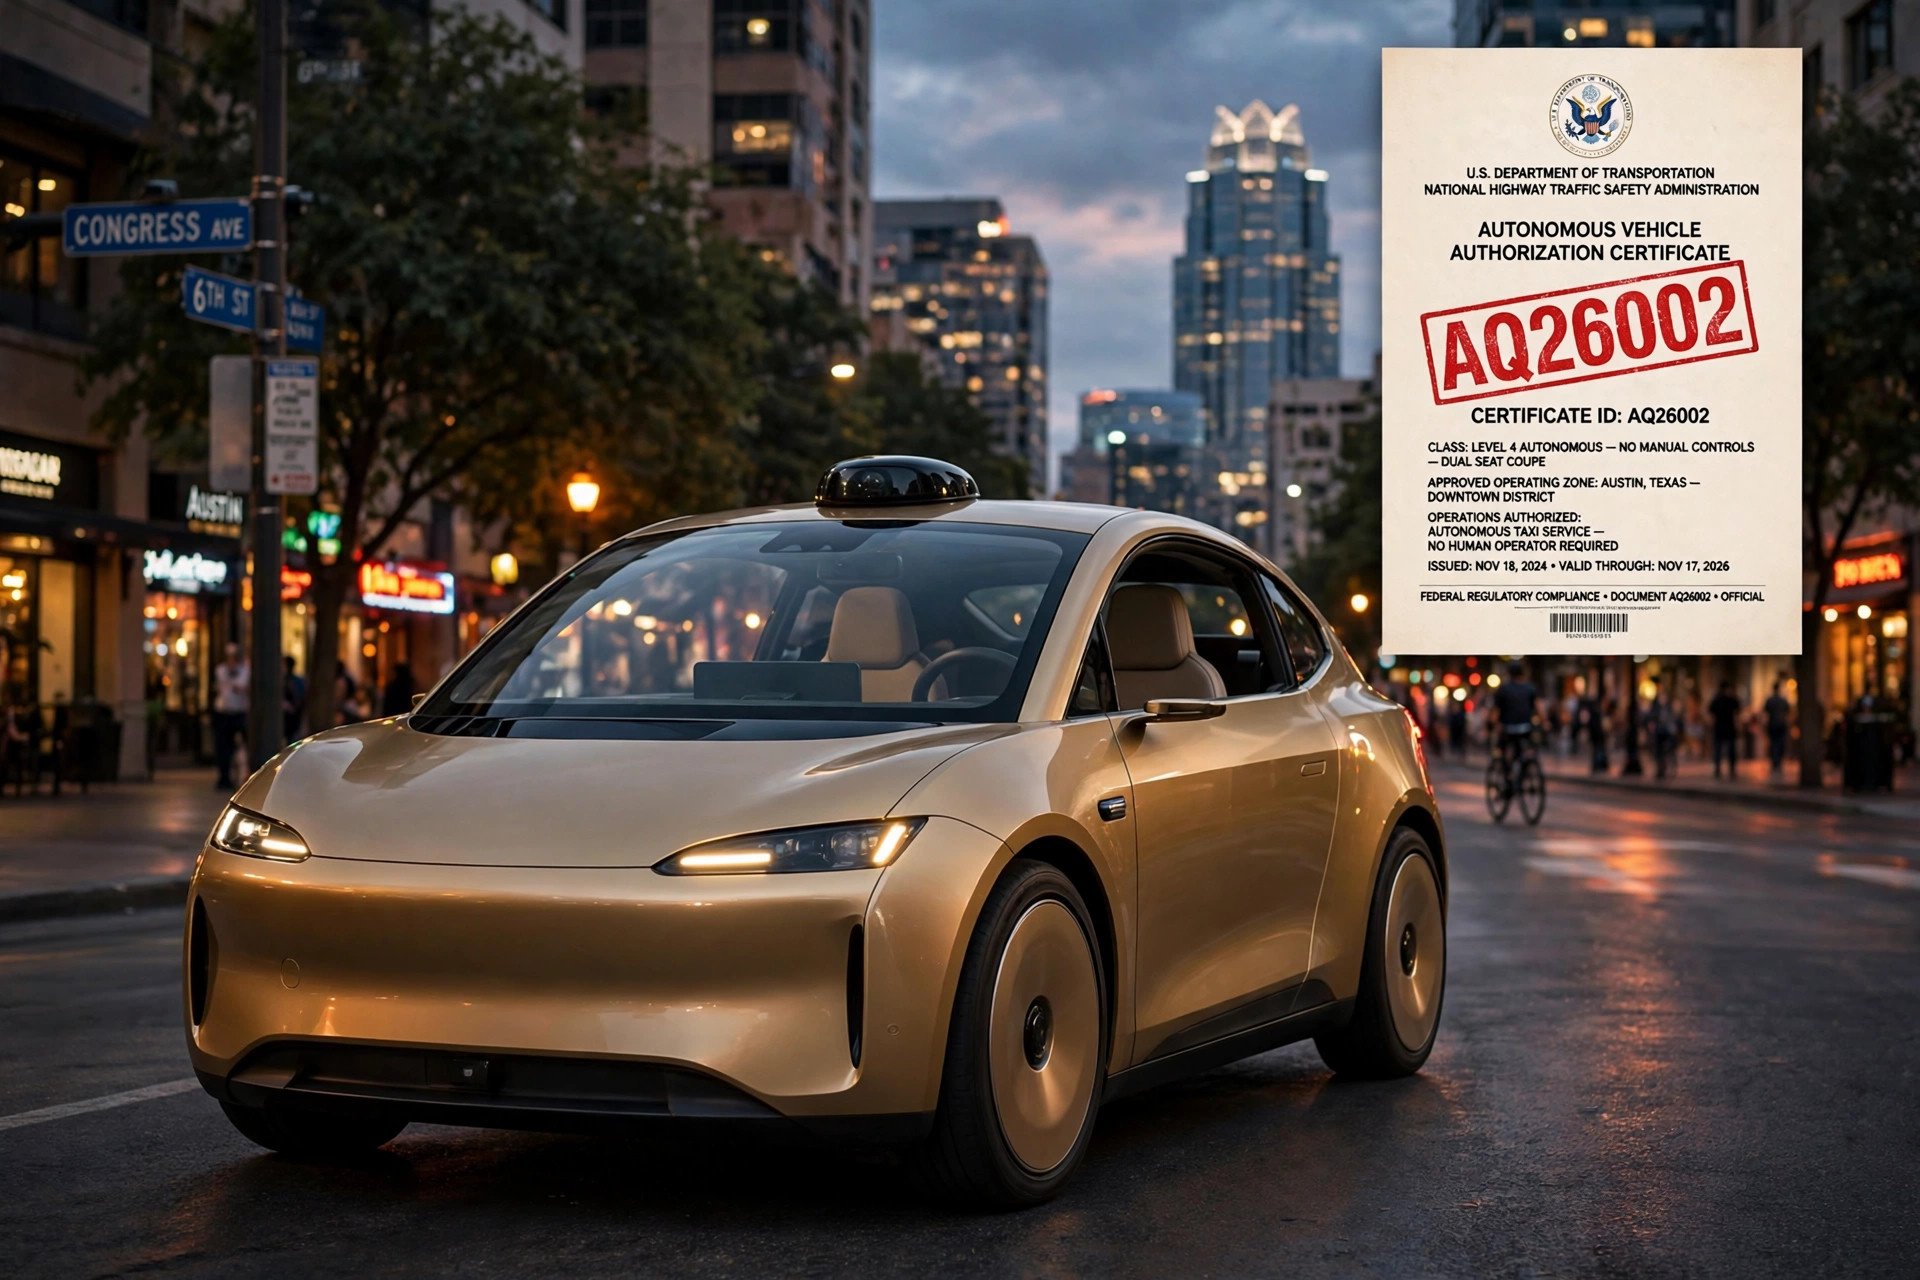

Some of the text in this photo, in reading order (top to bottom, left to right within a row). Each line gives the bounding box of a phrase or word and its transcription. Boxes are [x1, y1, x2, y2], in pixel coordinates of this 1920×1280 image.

[74, 210, 245, 247] CONGRESS AVE
[193, 278, 226, 314] 6TH
[231, 287, 251, 317] ST
